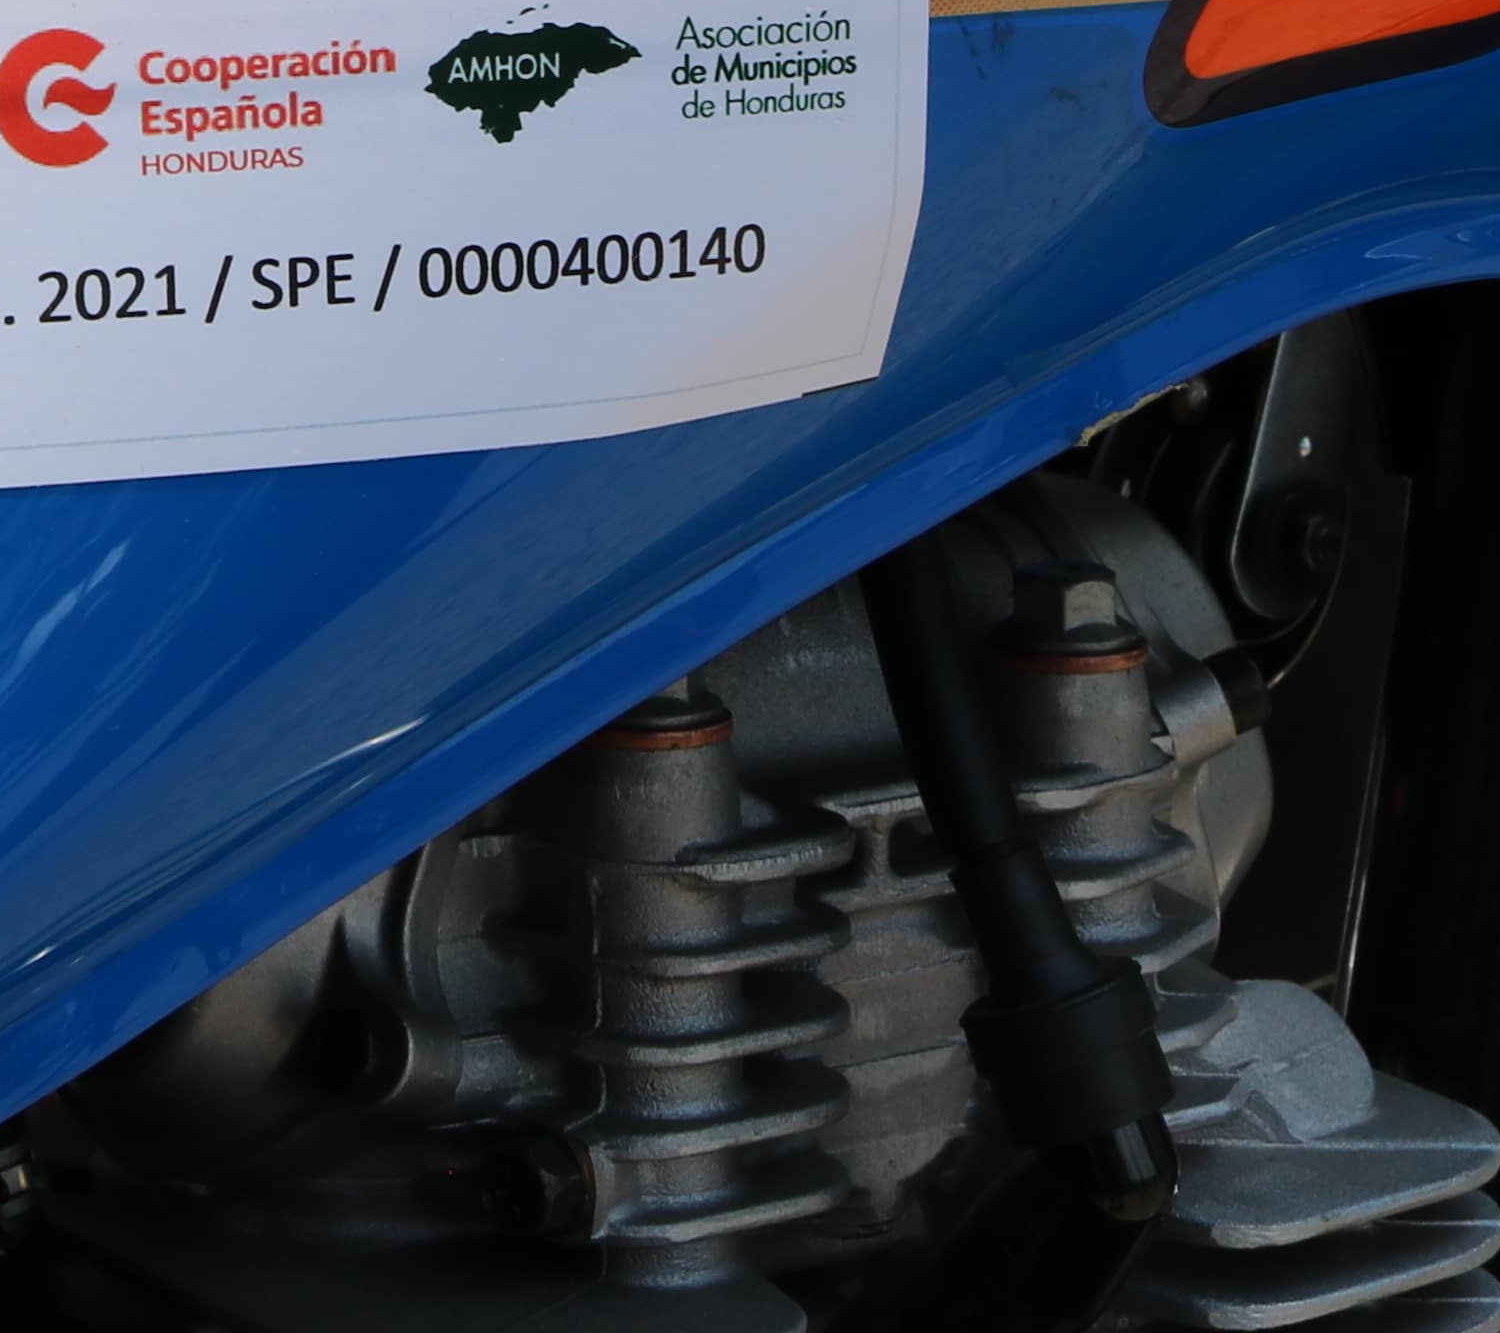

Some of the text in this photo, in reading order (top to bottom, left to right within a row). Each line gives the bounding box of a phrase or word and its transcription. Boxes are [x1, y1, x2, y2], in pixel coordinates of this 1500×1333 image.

[675, 9, 851, 51] Asociación
[137, 39, 397, 92] Cooperación
[447, 51, 561, 85] AMHON
[670, 48, 857, 86] de Municipios
[139, 90, 324, 142] Española
[681, 82, 846, 119] de Honduras
[141, 145, 305, 176] HONDURAS
[37, 264, 187, 324] 2021
[204, 254, 234, 325] /
[251, 253, 356, 311] SPE
[372, 243, 402, 313] /
[418, 223, 766, 299] 0000400140
